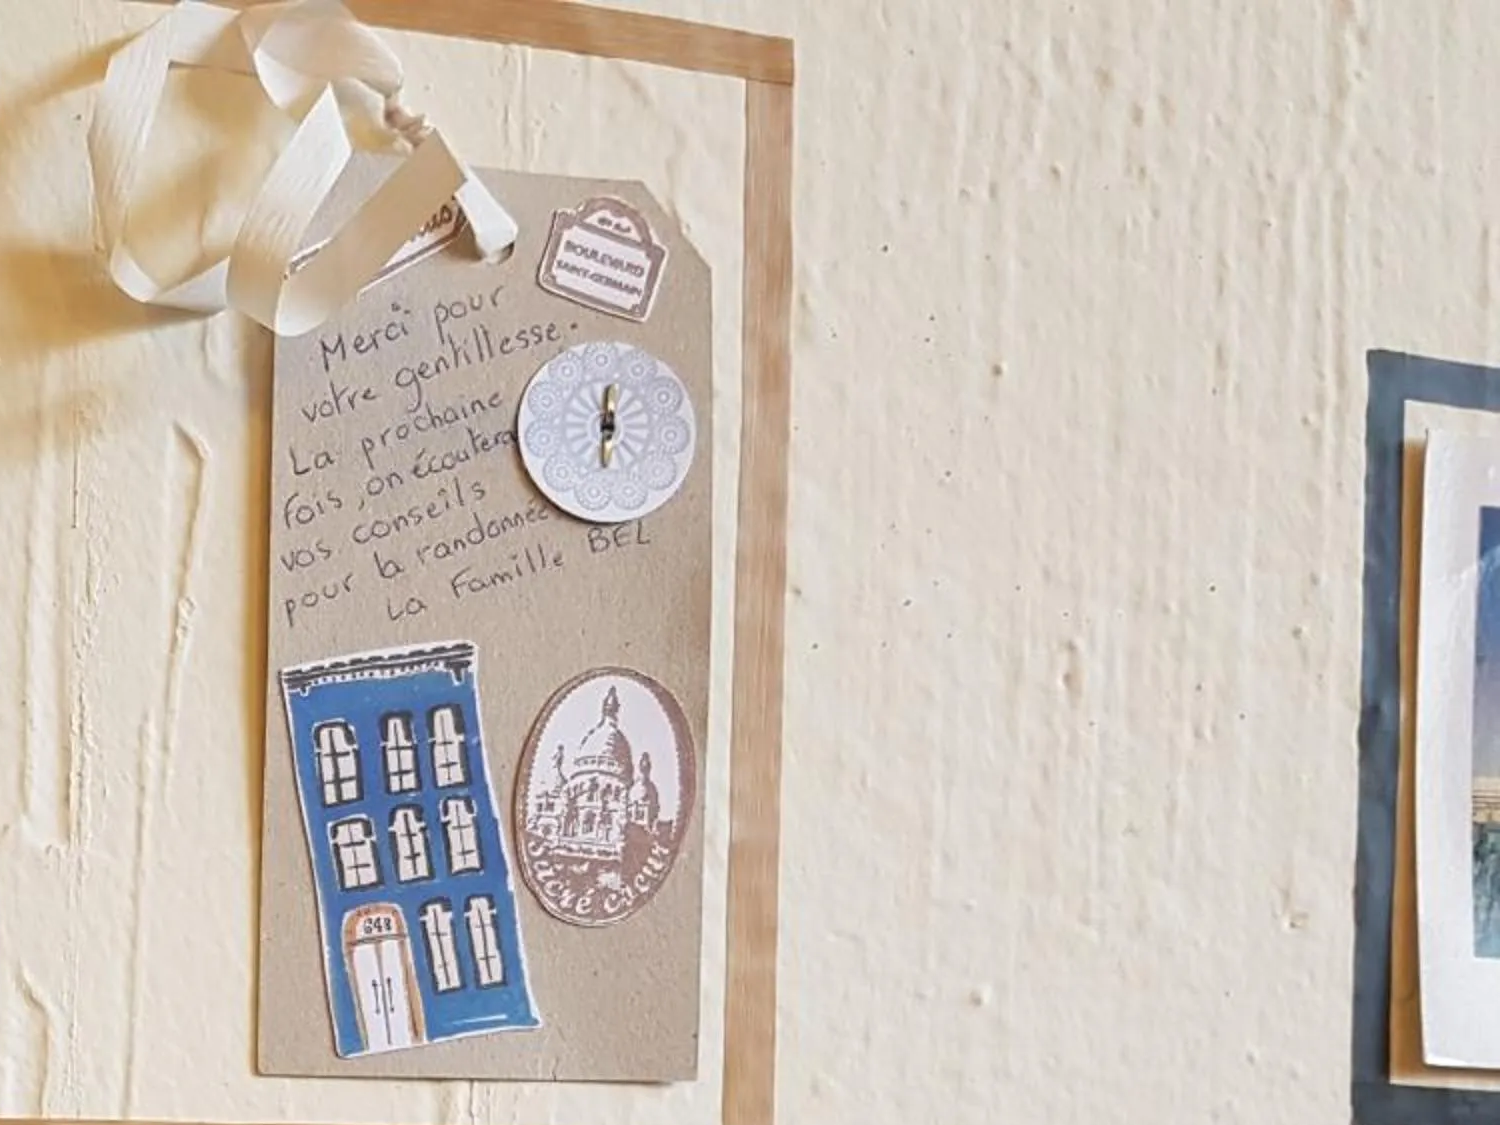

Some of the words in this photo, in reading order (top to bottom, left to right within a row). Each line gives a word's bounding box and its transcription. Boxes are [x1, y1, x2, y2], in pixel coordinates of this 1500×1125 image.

[564, 240, 645, 278] BOULEVARD
[320, 301, 411, 372] Merci
[434, 285, 504, 344] pour
[301, 380, 378, 423] votre
[360, 391, 505, 471] prochaine
[280, 540, 332, 572] vos
[352, 476, 486, 545] conseils
[449, 543, 565, 601] Famille
[586, 522, 652, 555] BEL
[285, 572, 354, 629] pour
